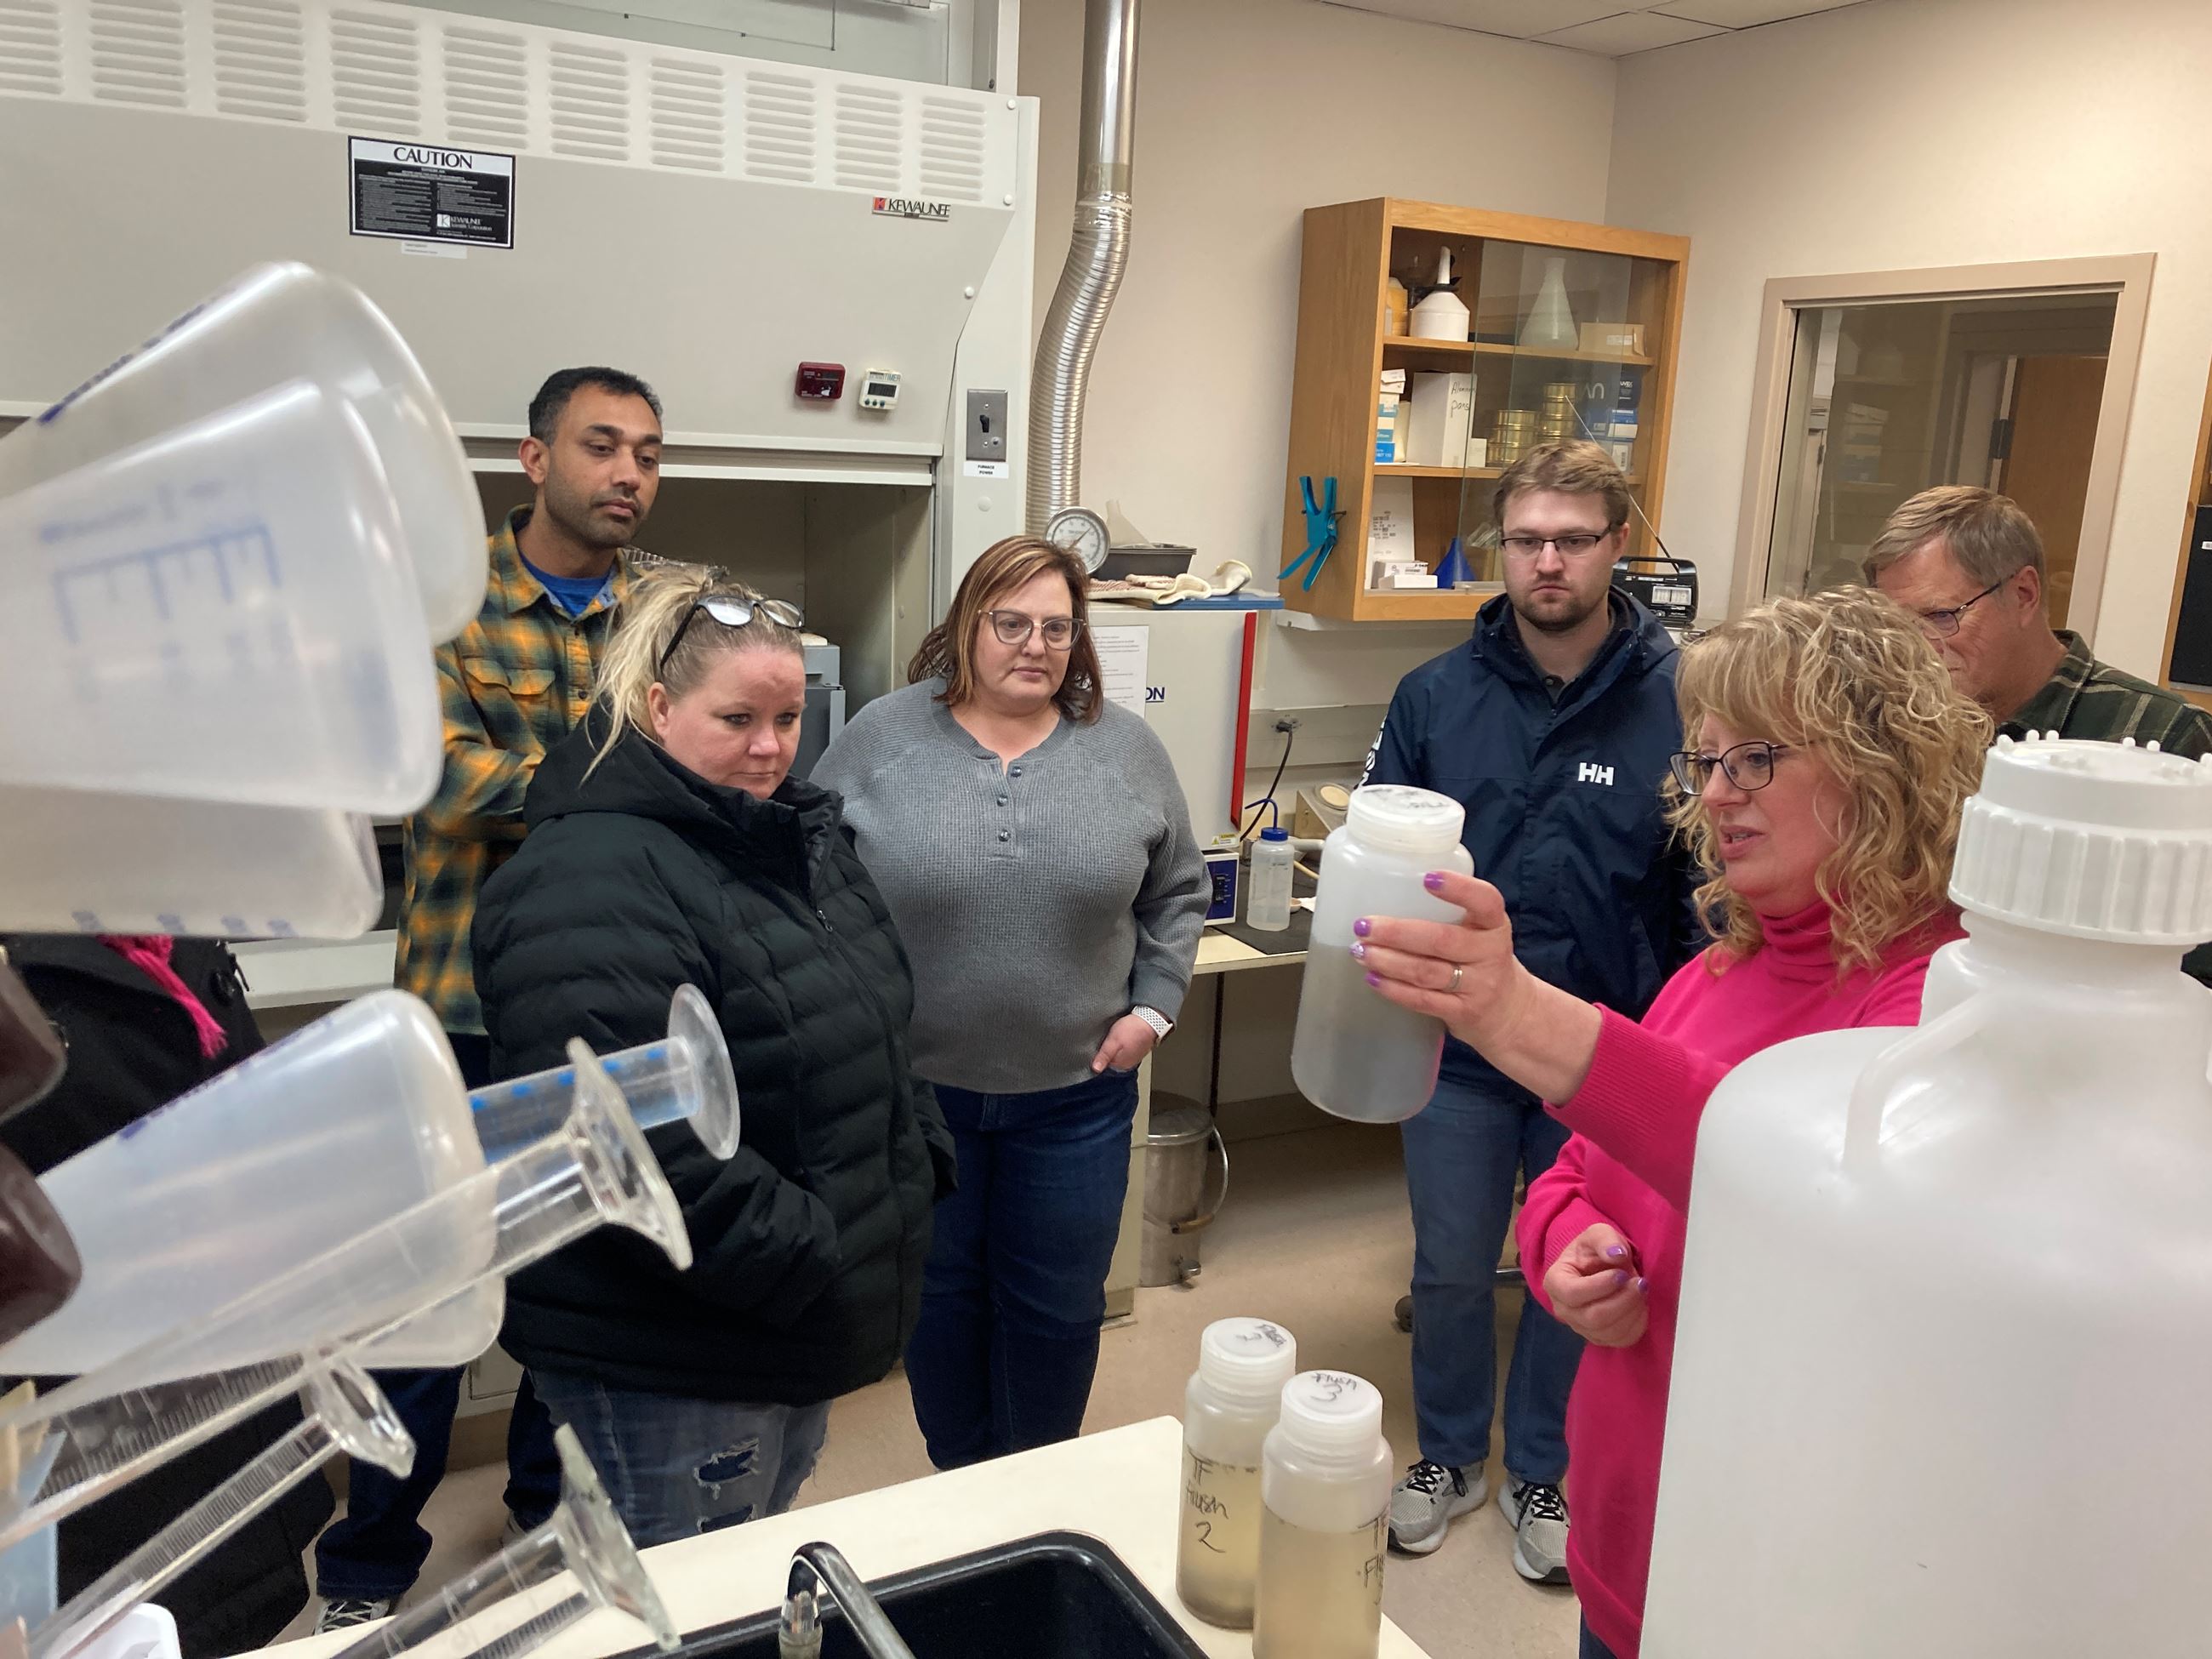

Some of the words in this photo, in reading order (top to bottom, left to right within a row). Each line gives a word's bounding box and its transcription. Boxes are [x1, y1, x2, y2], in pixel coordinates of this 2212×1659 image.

[394, 147, 472, 168] CAUTION
[884, 373, 902, 382] TIMER
[1577, 762, 1615, 786] HH
[1310, 1382, 1343, 1402] 3
[1194, 1521, 1227, 1554] 2
